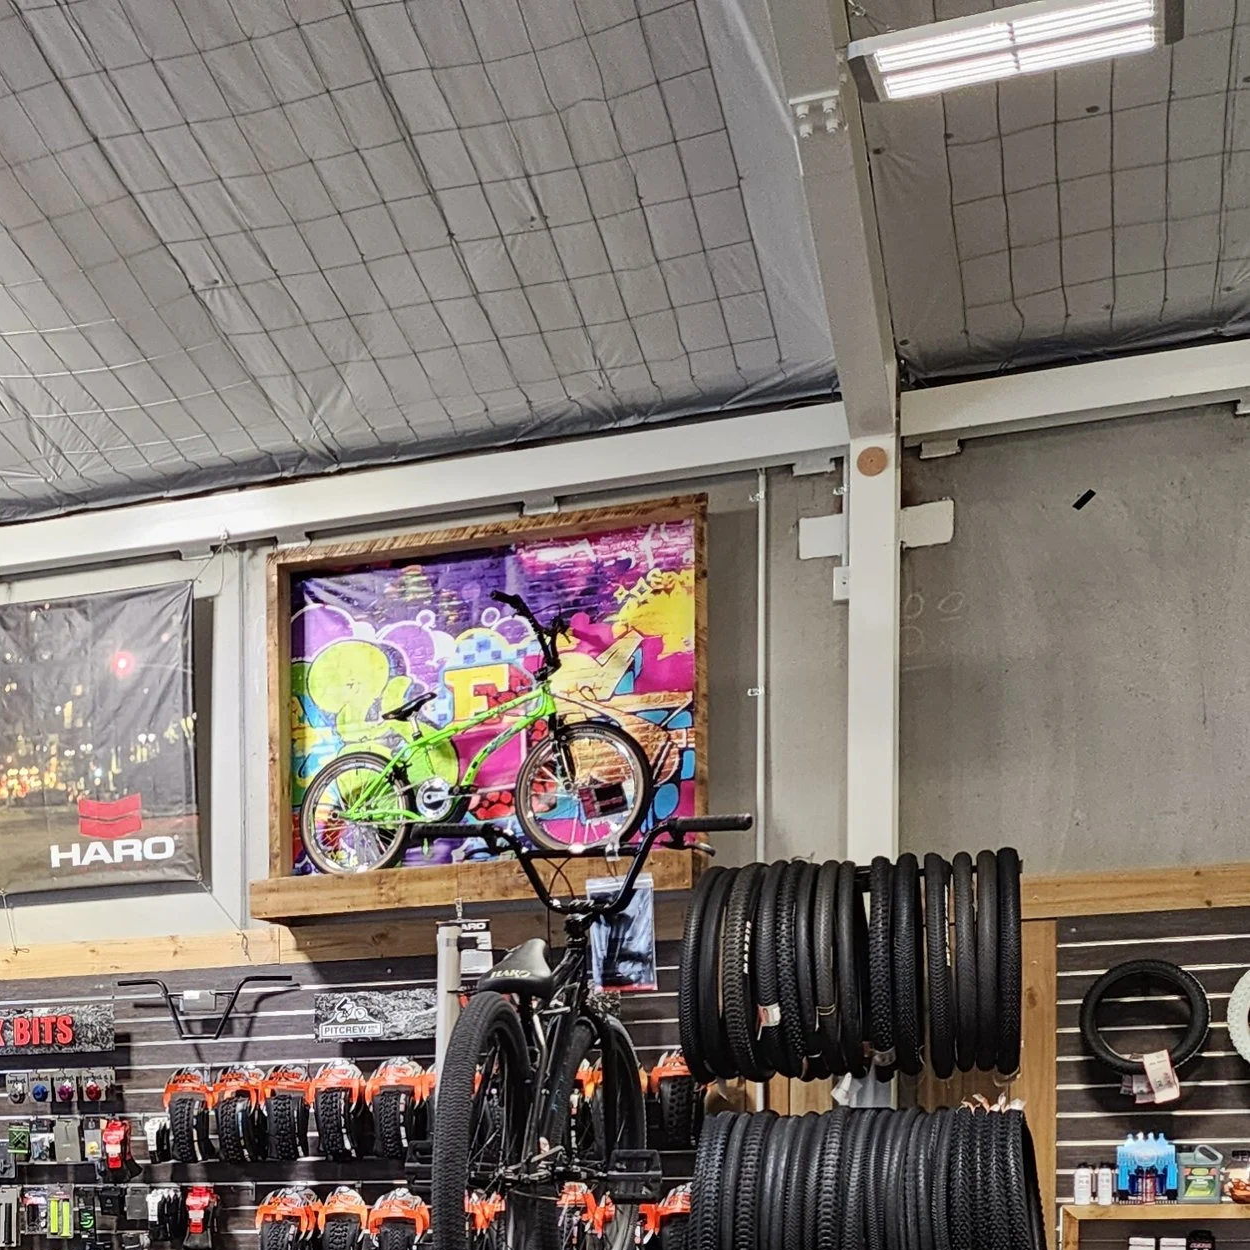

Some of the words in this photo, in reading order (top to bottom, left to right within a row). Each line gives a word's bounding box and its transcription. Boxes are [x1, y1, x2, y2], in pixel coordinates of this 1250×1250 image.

[50, 836, 175, 868] HARO
[460, 922, 487, 931] ARO
[490, 968, 532, 979] HARO
[13, 1014, 74, 1046] BITS
[324, 1026, 366, 1035] PITCREW
